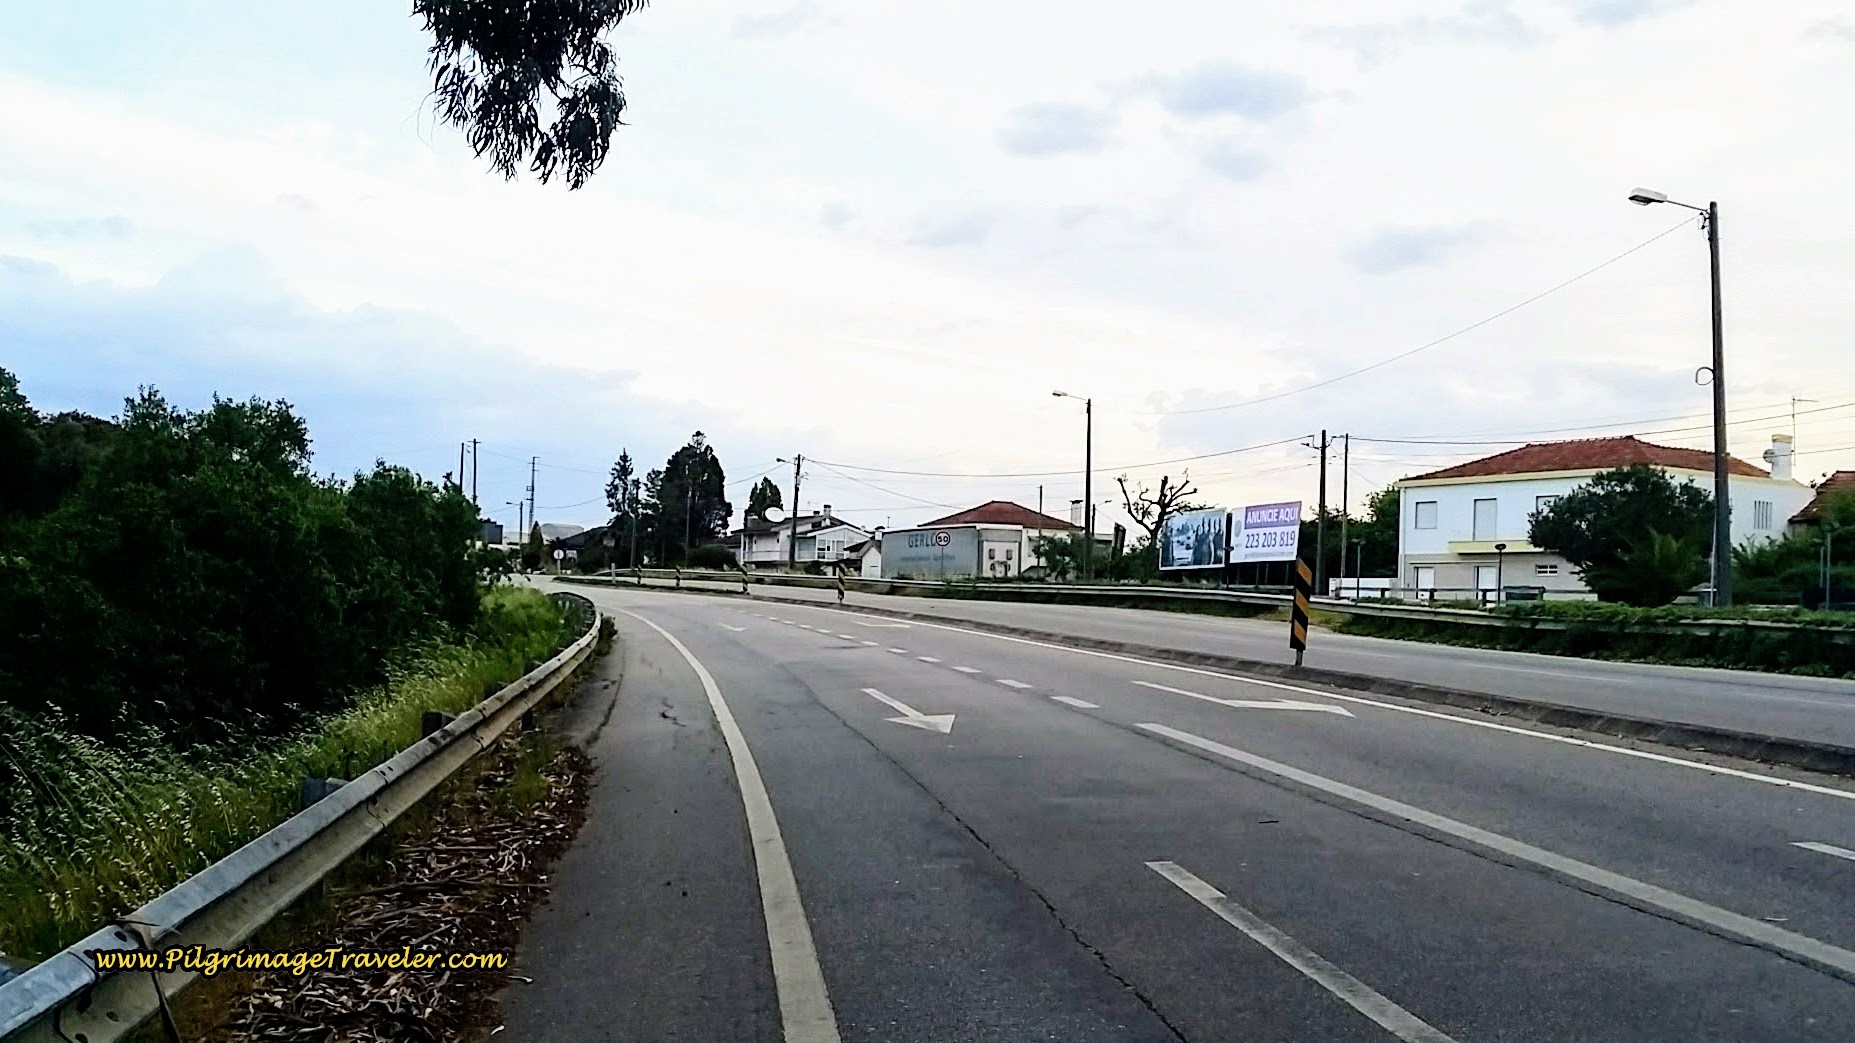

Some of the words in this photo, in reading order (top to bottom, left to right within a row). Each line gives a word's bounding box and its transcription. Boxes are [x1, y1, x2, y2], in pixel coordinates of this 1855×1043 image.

[1246, 509, 1278, 523] ANUNCIE
[1279, 507, 1298, 522] AQUI
[1245, 533, 1260, 549] 223
[1262, 531, 1277, 547] 203
[1279, 530, 1295, 547] 819
